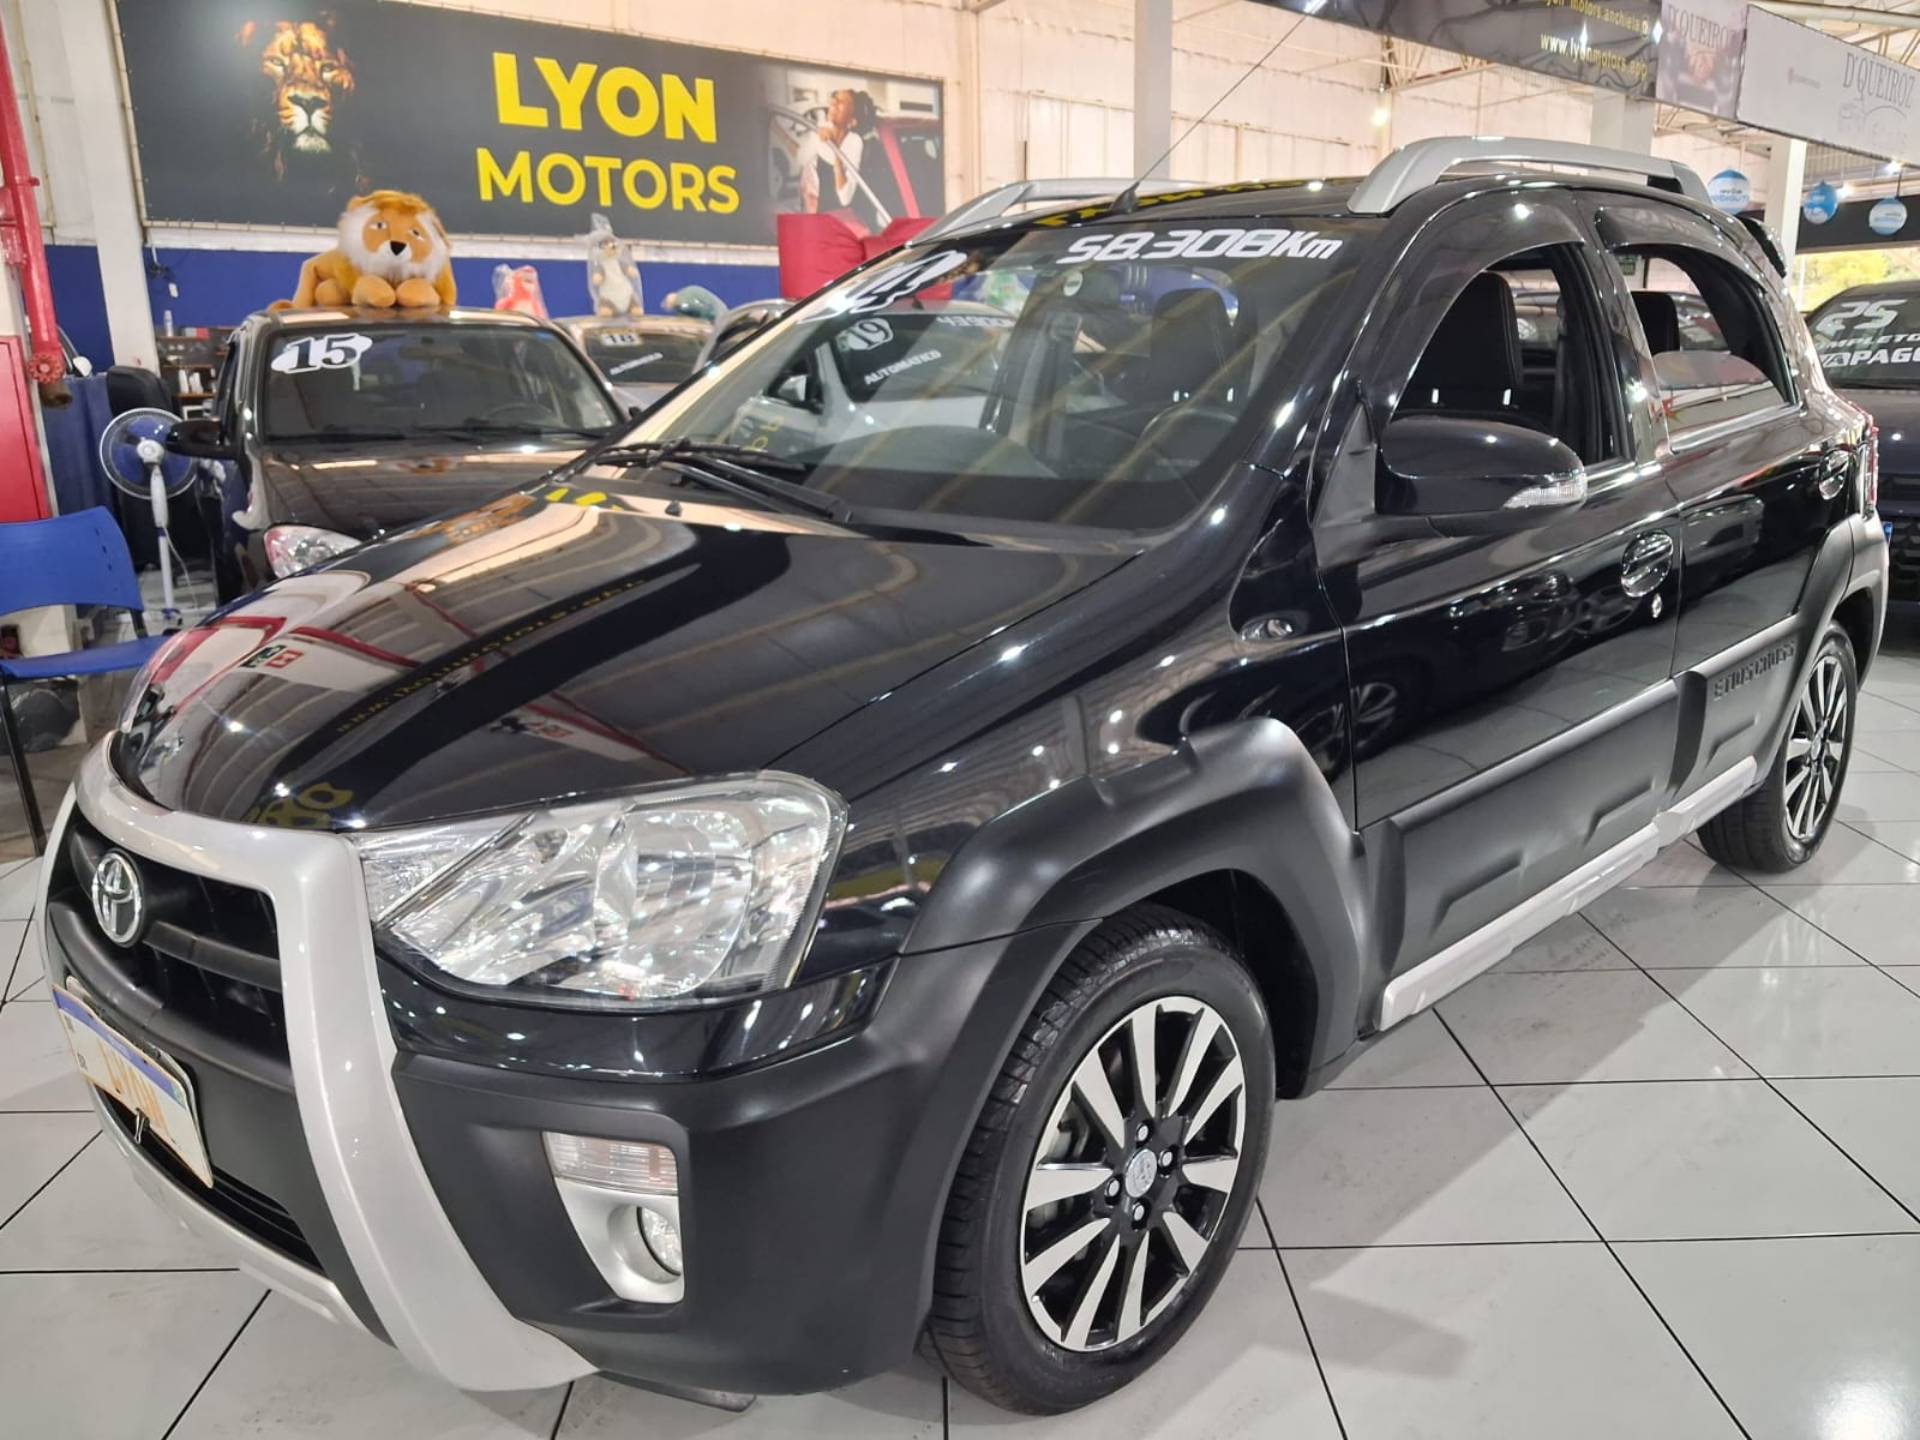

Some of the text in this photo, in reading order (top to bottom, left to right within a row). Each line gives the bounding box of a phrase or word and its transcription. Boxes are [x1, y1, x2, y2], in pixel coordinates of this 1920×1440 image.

[493, 52, 717, 143] LYON
[477, 147, 740, 214] MOTORS
[1816, 299, 1908, 333] 25
[286, 335, 360, 372] 15
